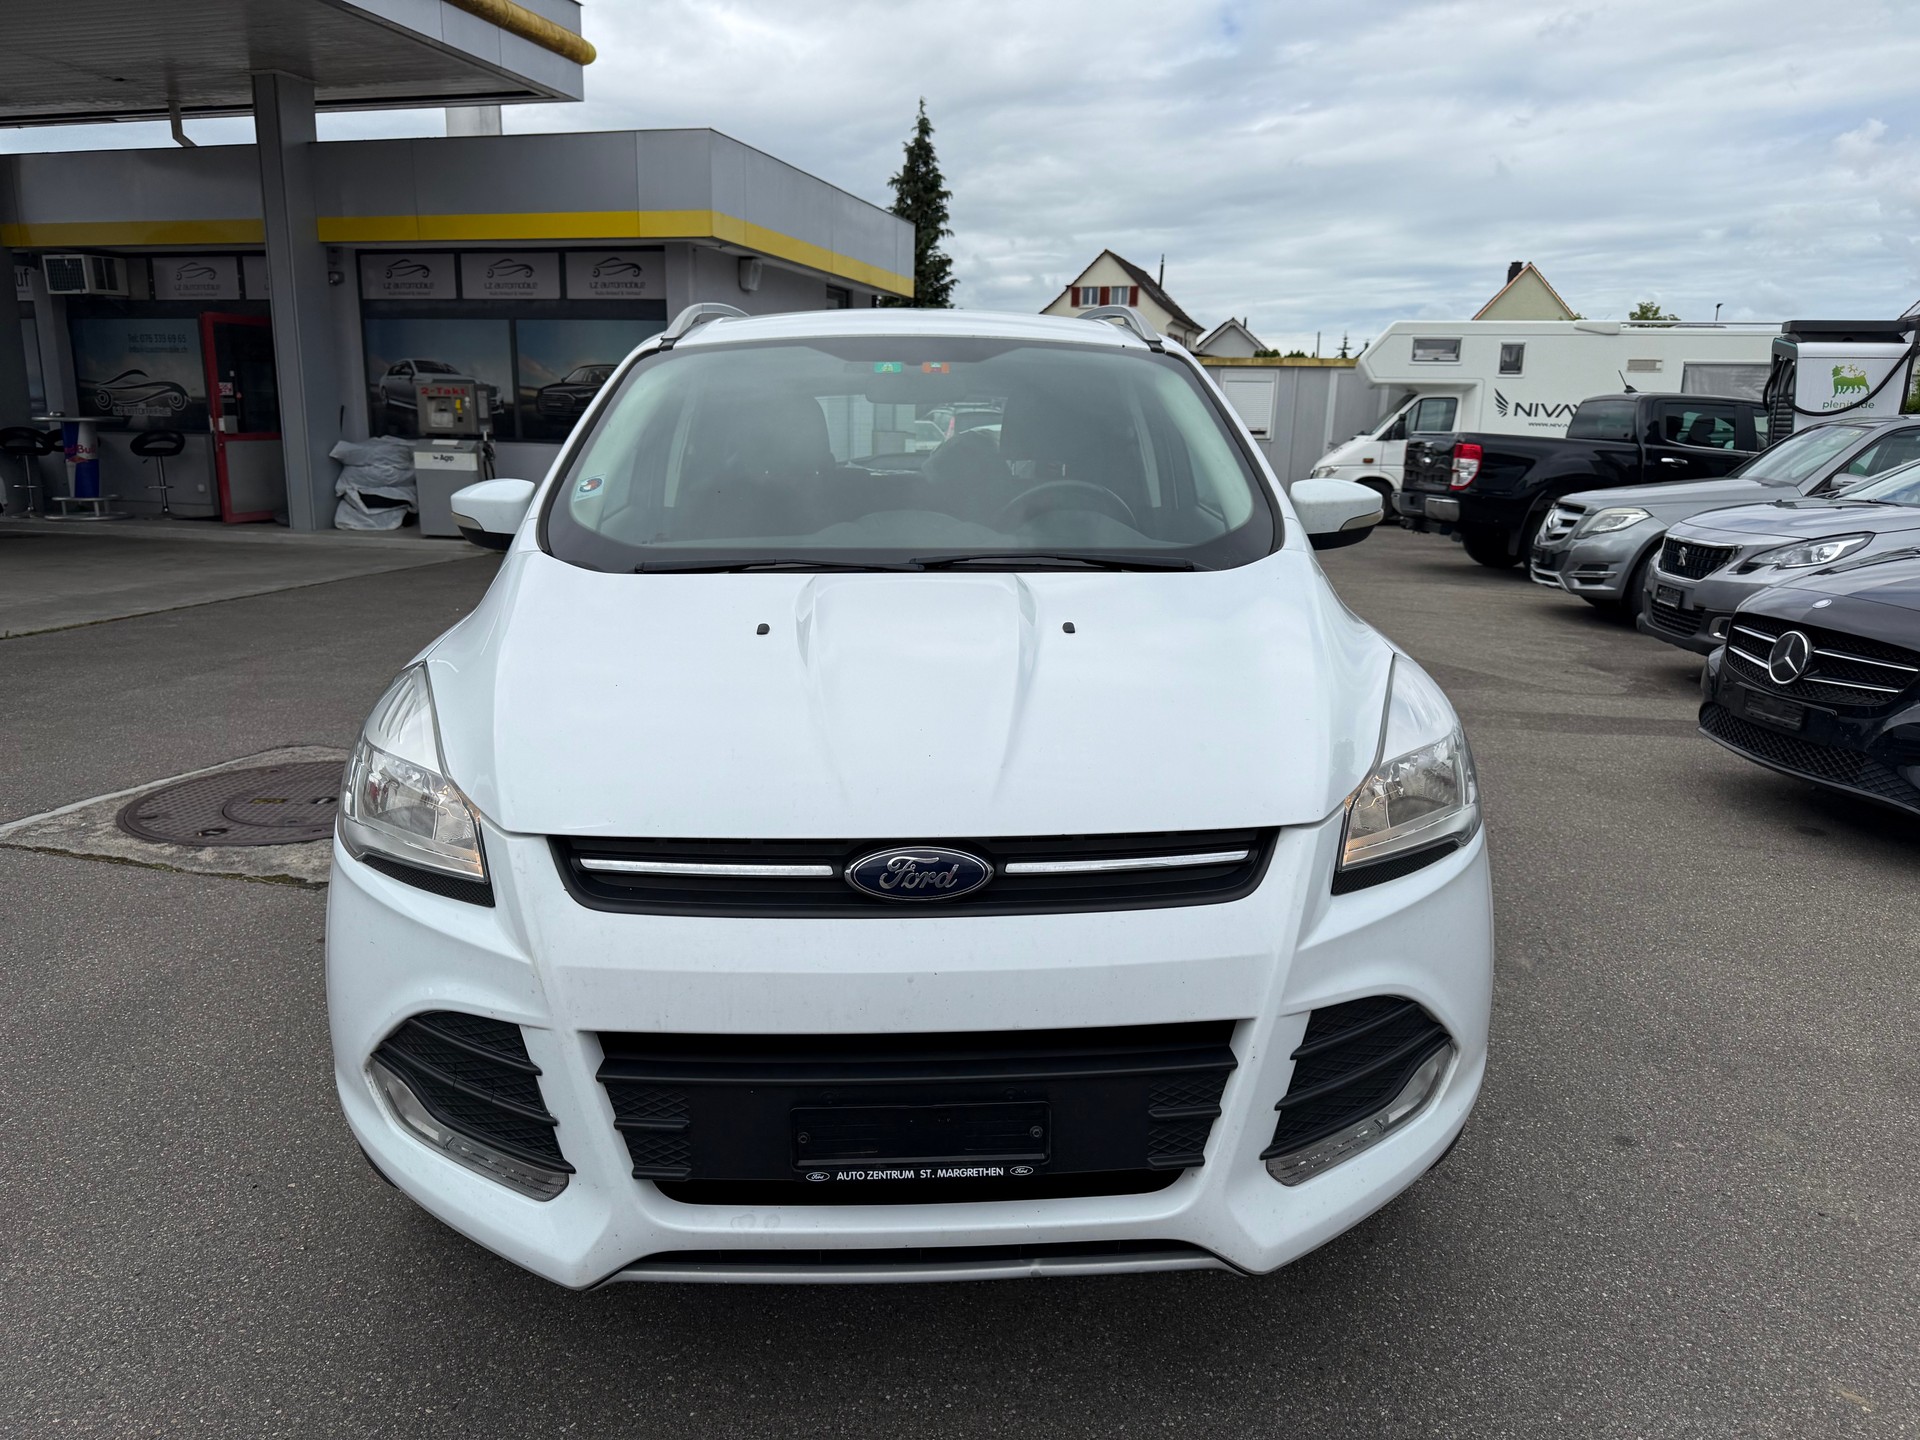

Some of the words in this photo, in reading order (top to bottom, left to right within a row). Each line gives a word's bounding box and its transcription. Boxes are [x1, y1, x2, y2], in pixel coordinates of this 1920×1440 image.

[879, 856, 960, 889] Ford
[836, 1171, 865, 1181] AUTO
[867, 1170, 914, 1180] ZENTRUM
[920, 1169, 935, 1179] ST.
[937, 1167, 1004, 1179] MARGRETHEN
